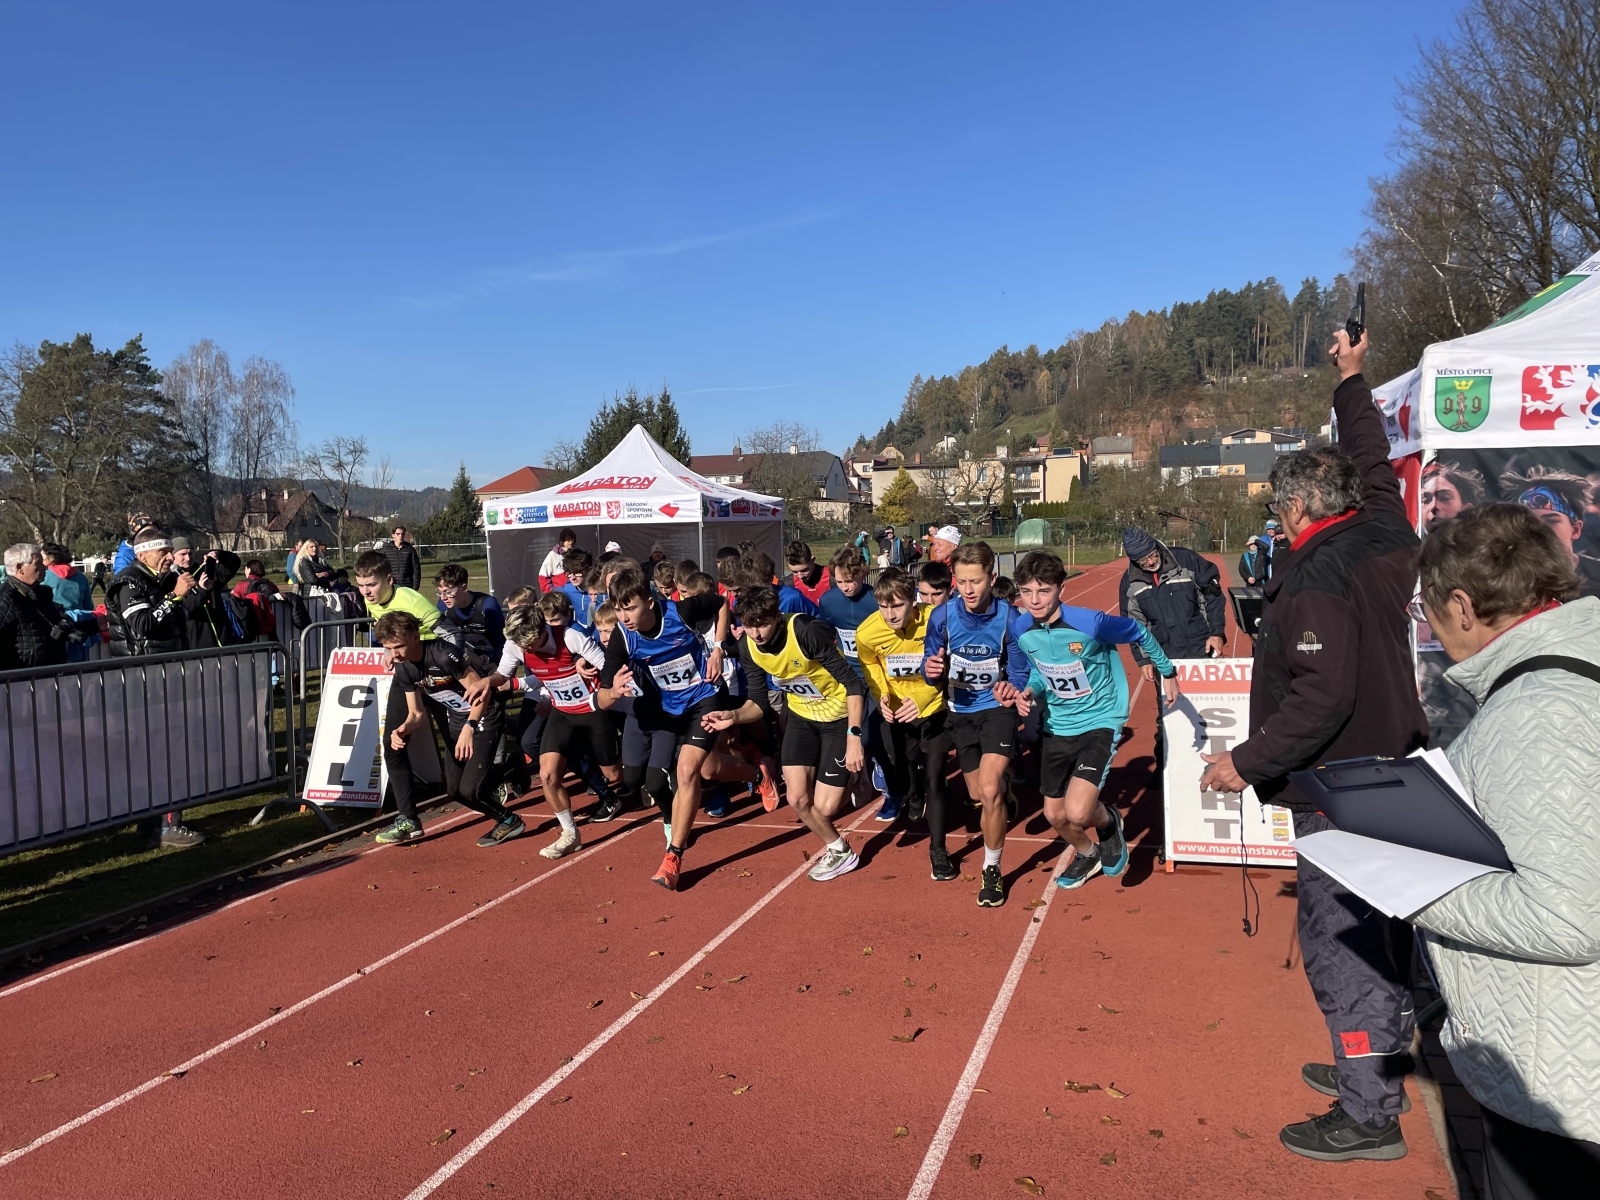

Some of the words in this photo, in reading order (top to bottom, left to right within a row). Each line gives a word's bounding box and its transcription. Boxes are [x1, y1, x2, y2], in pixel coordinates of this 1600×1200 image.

[563, 476, 657, 490] MARATON
[554, 501, 600, 513] MARATON
[332, 652, 385, 665] MARAT
[953, 657, 971, 667] ZIMNÍ
[659, 668, 692, 685] 134
[956, 671, 992, 685] 129
[1176, 664, 1252, 682] MARAT
[1047, 677, 1080, 691] 121
[553, 686, 583, 701] 136
[1198, 707, 1241, 840] STRT
[309, 790, 378, 801] www.maratonstav.cz
